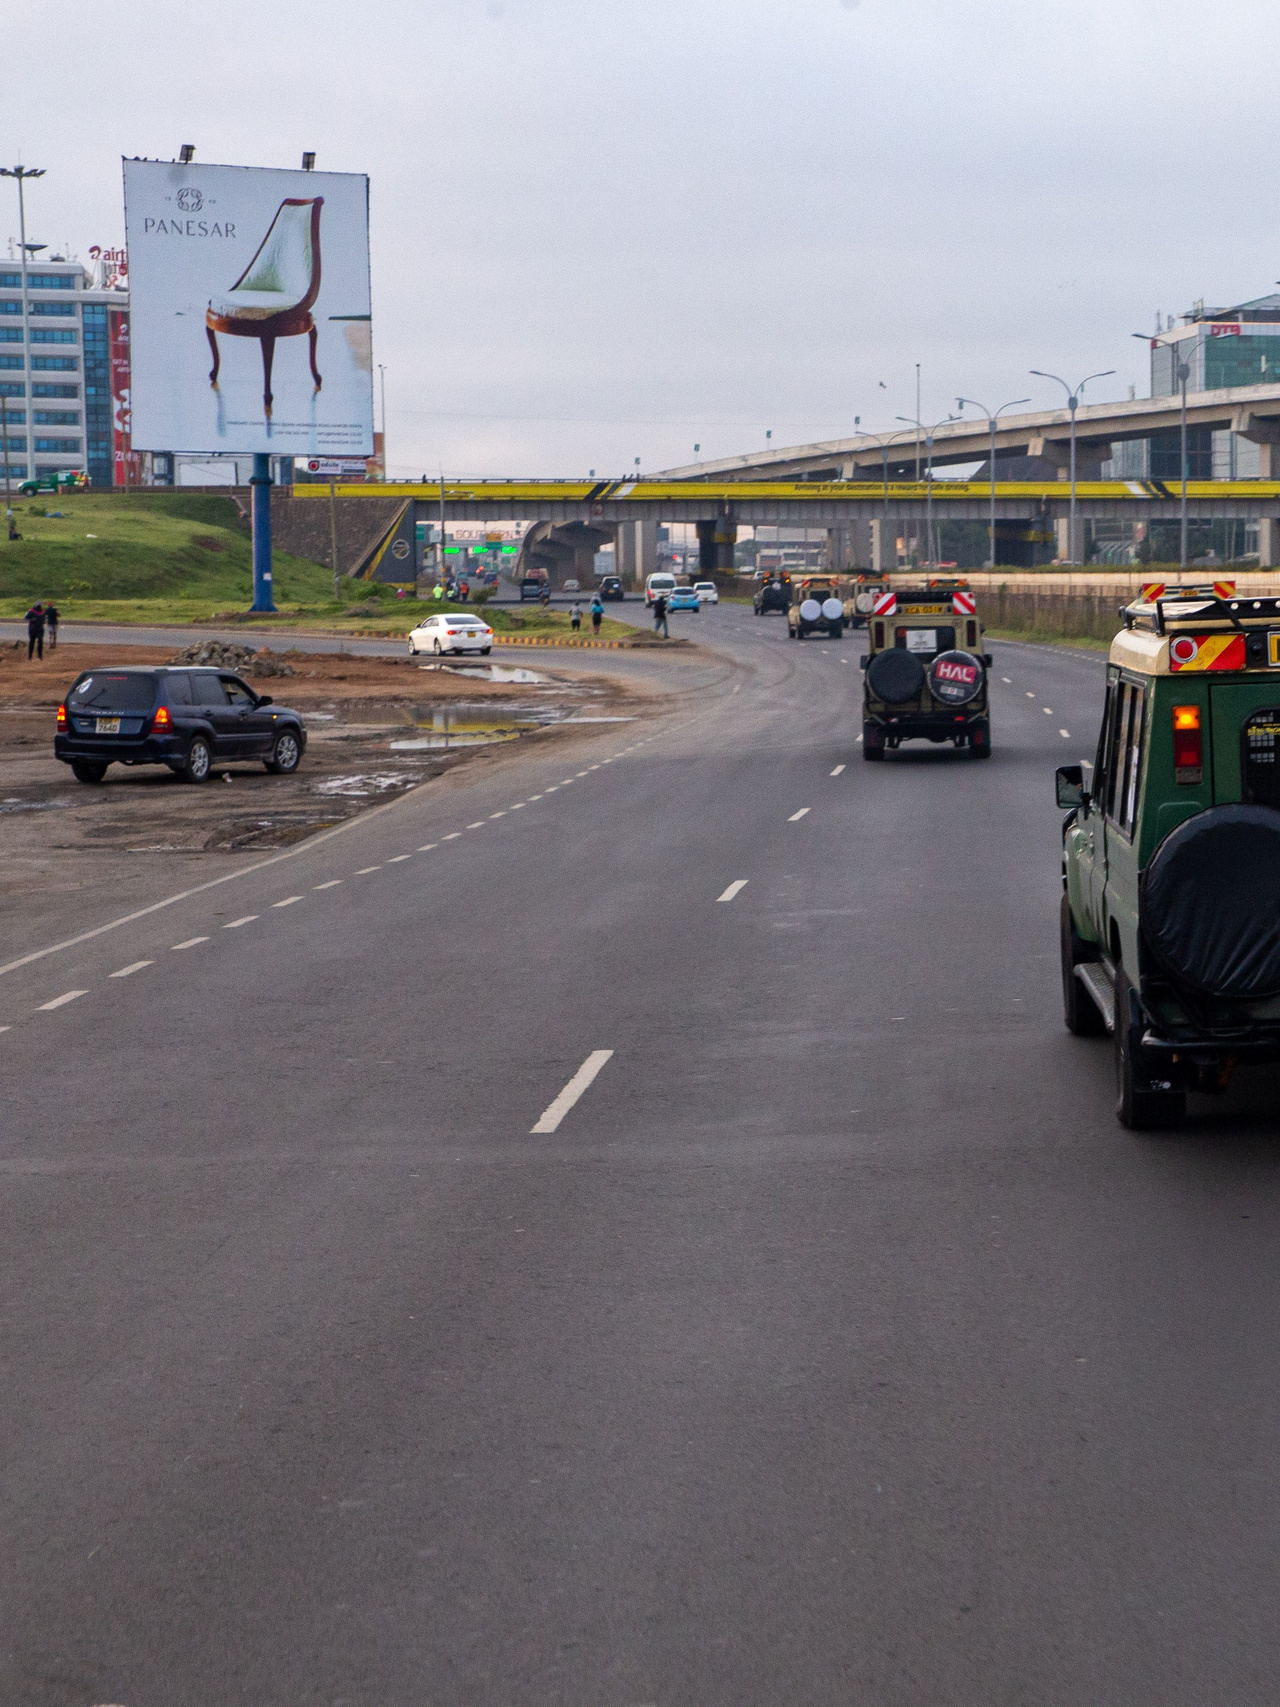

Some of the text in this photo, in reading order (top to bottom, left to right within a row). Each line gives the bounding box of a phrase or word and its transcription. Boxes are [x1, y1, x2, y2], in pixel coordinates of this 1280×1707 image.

[144, 217, 236, 238] PANESAR
[103, 247, 126, 260] airt
[939, 663, 972, 681] HAL
